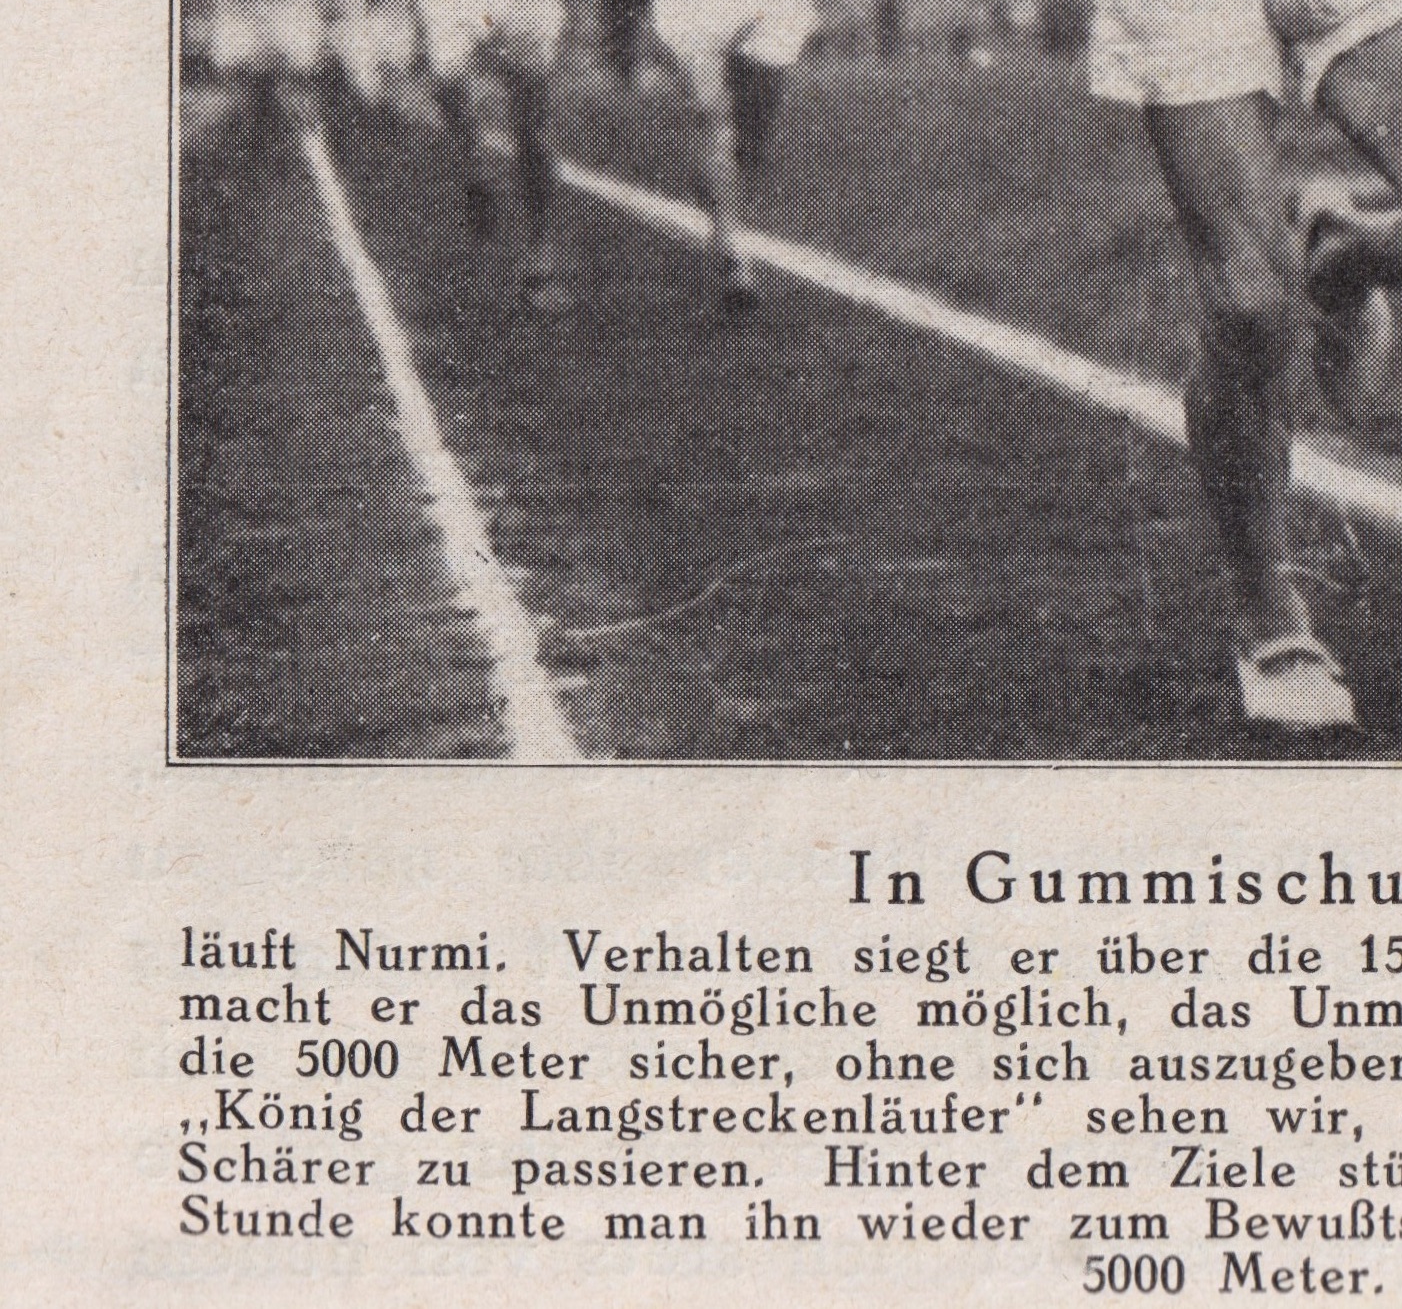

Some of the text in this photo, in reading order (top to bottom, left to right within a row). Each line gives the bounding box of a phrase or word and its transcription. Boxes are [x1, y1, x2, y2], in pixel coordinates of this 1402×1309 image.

[849, 850, 925, 905] In
[181, 926, 296, 971] läuft
[335, 928, 506, 972] Nurmi.
[562, 929, 813, 973] Verhalten
[854, 934, 970, 983] siegt
[1010, 948, 1059, 975] er
[1097, 932, 1209, 975] über
[1248, 932, 1321, 975] die
[179, 982, 331, 1026] macht
[371, 997, 420, 1025] er
[460, 984, 541, 1027] das
[580, 983, 876, 1036] Unmögliche
[917, 985, 1127, 1037] möglich,
[1170, 986, 1251, 1028] das
[179, 1035, 254, 1078] die
[296, 1038, 399, 1079] 5000
[438, 1035, 590, 1080] Meter
[630, 1038, 793, 1088] sicher,
[836, 1039, 954, 1081] ohne
[993, 1040, 1090, 1082] sich
[400, 1091, 481, 1133] der
[1087, 1092, 1228, 1135] sehen
[1266, 1095, 1362, 1143] wir,
[178, 1141, 375, 1187] Schärer
[417, 1160, 470, 1187] zu
[512, 1148, 763, 1195] passieren.
[824, 1145, 986, 1188] Hinter
[1027, 1147, 1129, 1189] dem
[1170, 1145, 1295, 1188] Ziele
[180, 1195, 353, 1238] Stunde
[392, 1196, 564, 1241] konnte
[605, 1214, 706, 1240] man
[746, 1199, 821, 1240] ihn
[859, 1199, 1030, 1241] wieder
[1070, 1214, 1169, 1240] zum
[1084, 1254, 1185, 1294] 5000
[1221, 1251, 1383, 1294] Meter.
